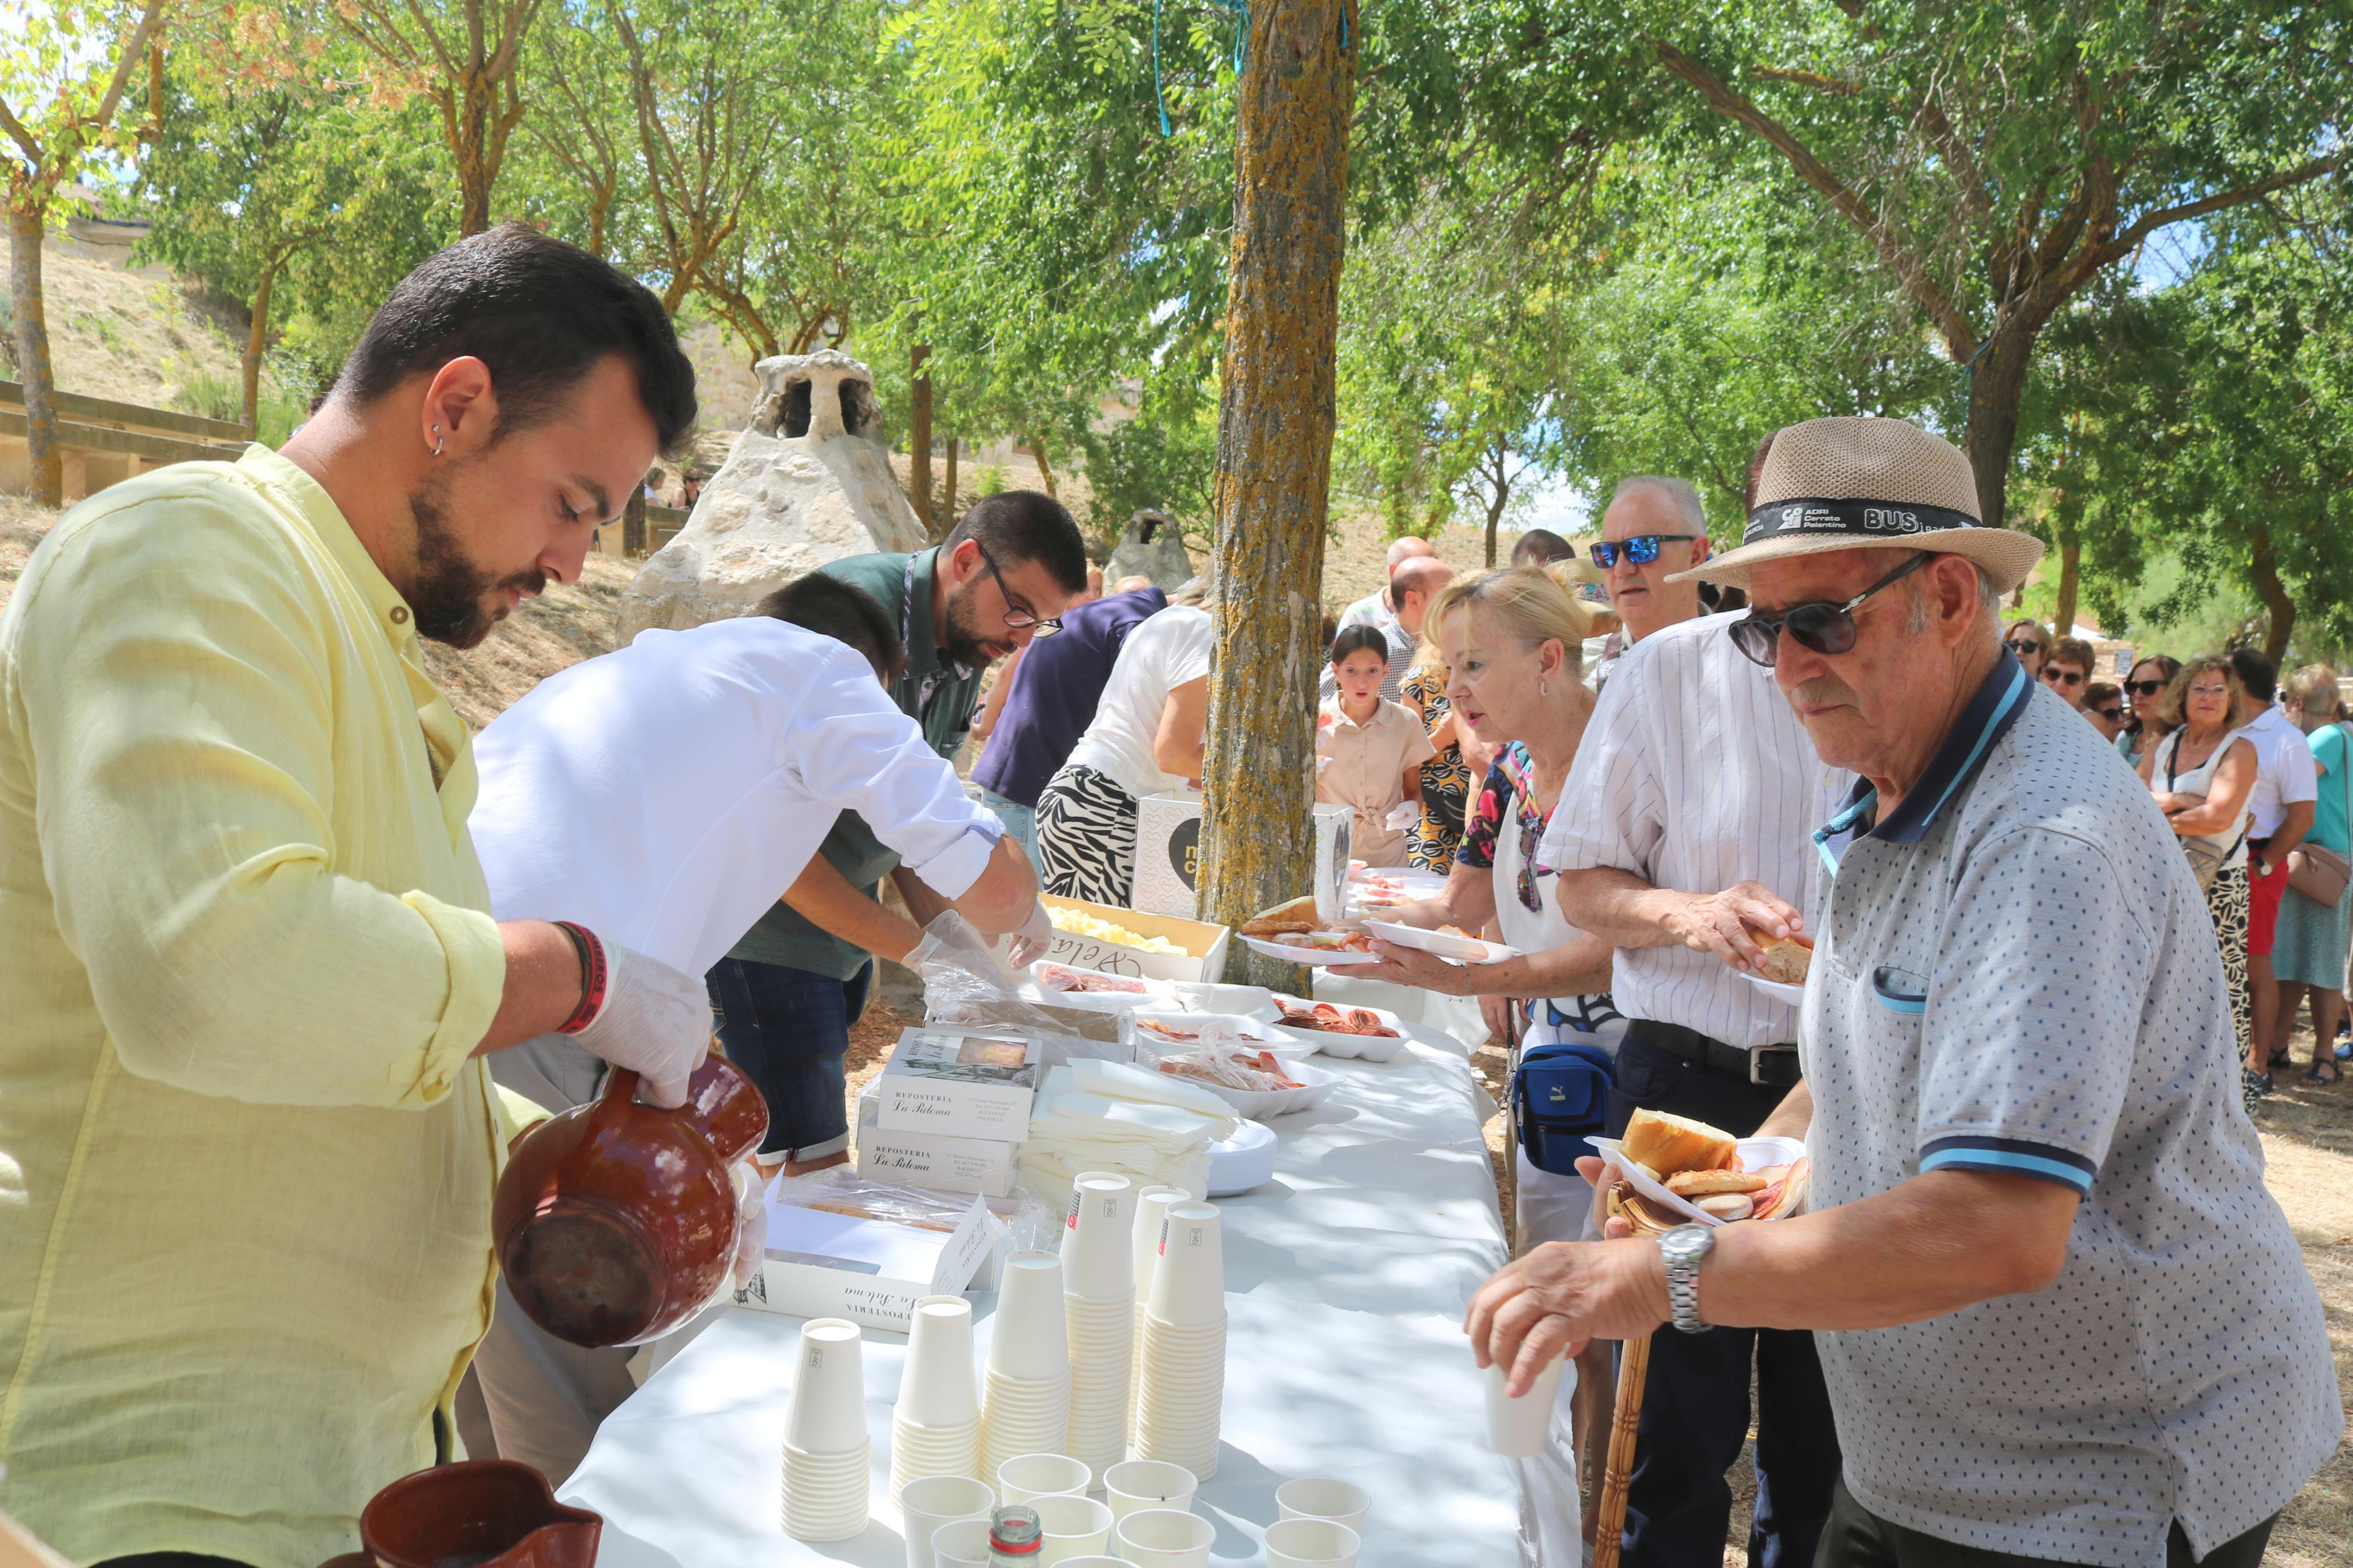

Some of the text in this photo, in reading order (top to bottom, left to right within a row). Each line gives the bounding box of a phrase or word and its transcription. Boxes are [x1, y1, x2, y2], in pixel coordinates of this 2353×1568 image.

[1864, 509, 1918, 532] BUS
[1052, 936, 1141, 978] Vela
[896, 1091, 952, 1103] REPOSTERIA
[893, 1099, 951, 1116] La Paloma
[876, 1146, 931, 1158] REPOSTERIA
[874, 1153, 929, 1171] La Paloma
[844, 1287, 894, 1307] Paloma
[847, 1304, 911, 1320] EPOSTERIA
